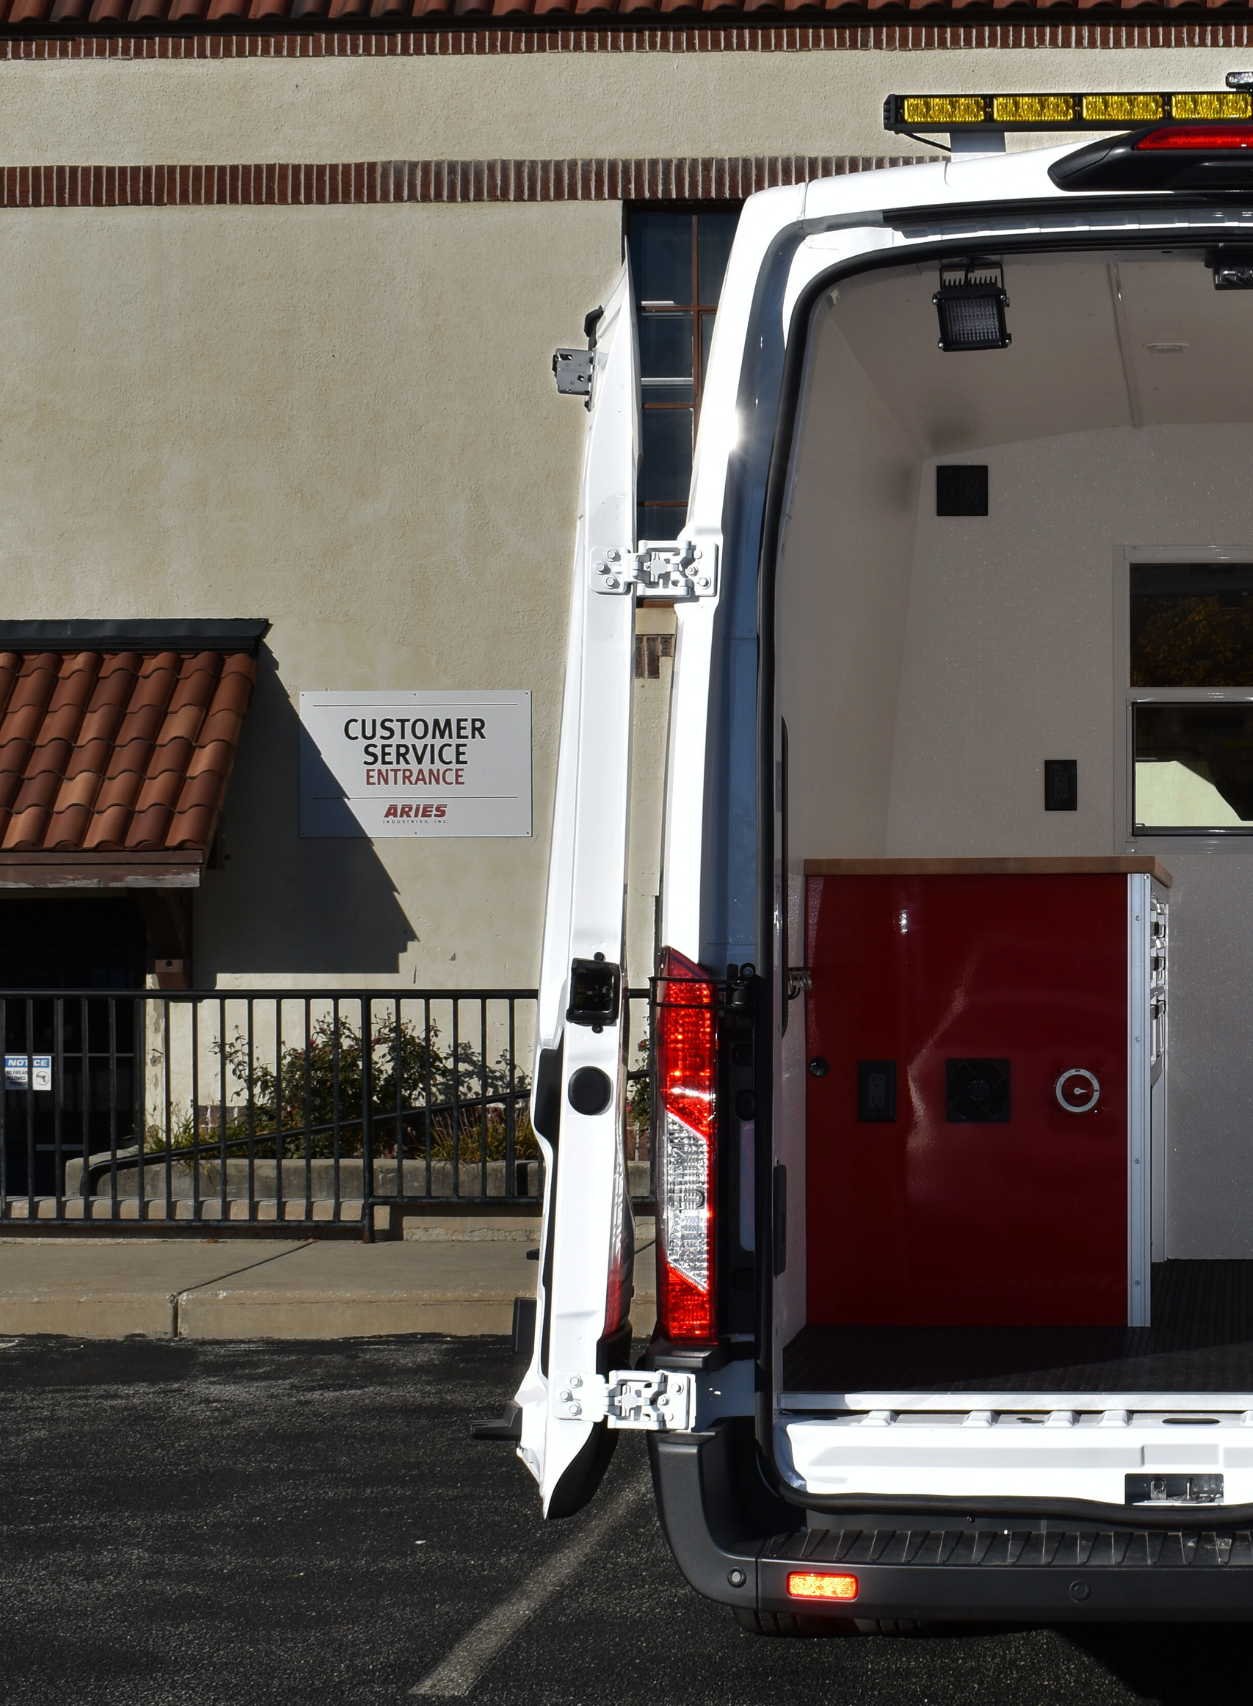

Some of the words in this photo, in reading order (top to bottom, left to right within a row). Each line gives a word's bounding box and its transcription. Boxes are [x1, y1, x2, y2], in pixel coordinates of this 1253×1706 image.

[344, 718, 486, 740] CUSTOMER
[363, 743, 468, 765] SERVICE
[366, 768, 465, 786] ENTRANCE
[384, 804, 448, 818] ARIES
